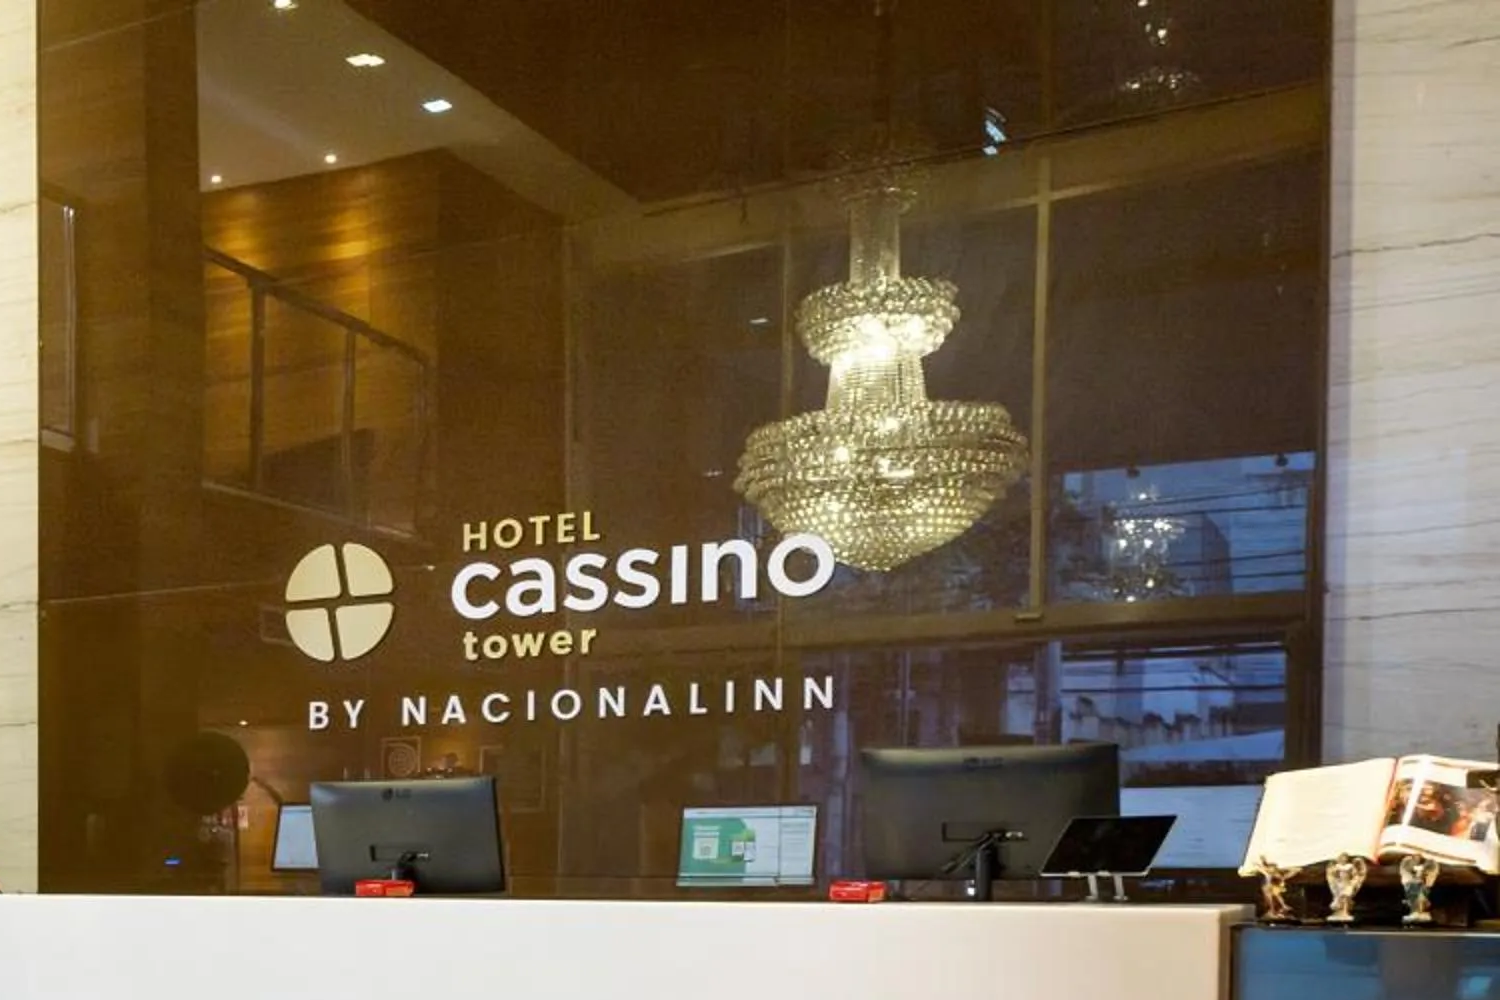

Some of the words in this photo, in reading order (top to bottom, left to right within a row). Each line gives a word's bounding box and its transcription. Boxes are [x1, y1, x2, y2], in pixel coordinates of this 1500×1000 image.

[462, 511, 601, 552] HOTEL
[451, 532, 835, 620] cassino
[462, 628, 597, 661] tower
[308, 700, 365, 730] BY
[401, 675, 834, 727] NACIONALINN
